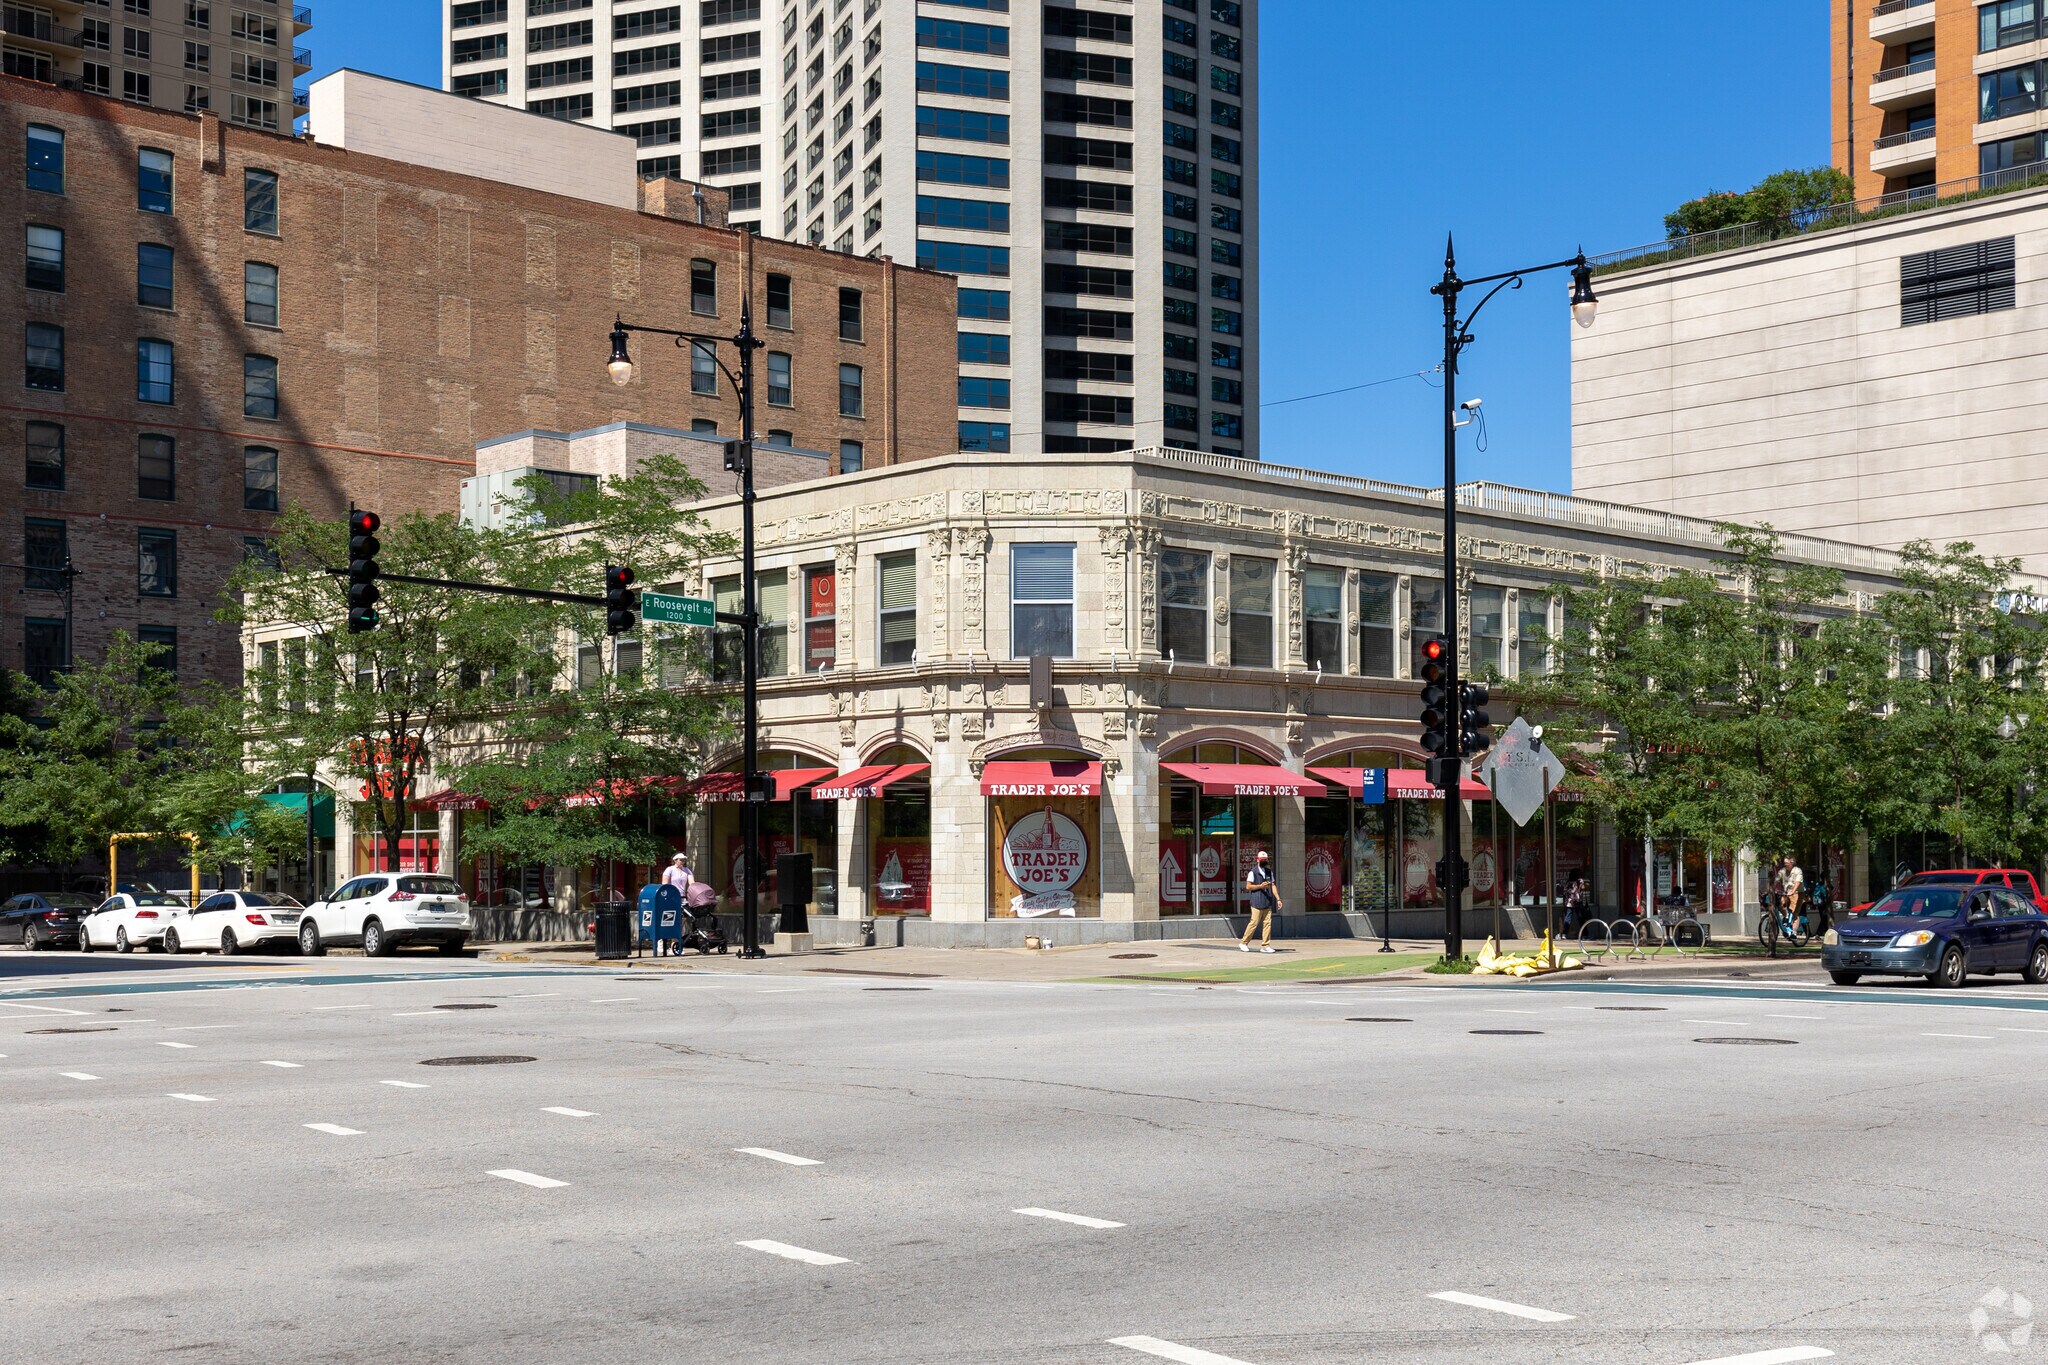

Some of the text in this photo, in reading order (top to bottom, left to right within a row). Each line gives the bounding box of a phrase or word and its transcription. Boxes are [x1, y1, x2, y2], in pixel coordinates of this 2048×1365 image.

[645, 597, 712, 615] E Roosevelt Rd
[666, 611, 692, 621] 1200 S
[816, 786, 877, 799] TRADER JOE'S
[990, 783, 1091, 796] TRADER JOE'S
[1234, 784, 1299, 796] TRADER JOE'S
[1397, 788, 1446, 800] TRADER JOE
[695, 792, 724, 802] TRADER
[437, 800, 476, 811] TRADER JOE'S
[1011, 852, 1080, 867] TRADER
[1019, 867, 1071, 883] JOE'S
[1199, 887, 1224, 896] NTRANCE
